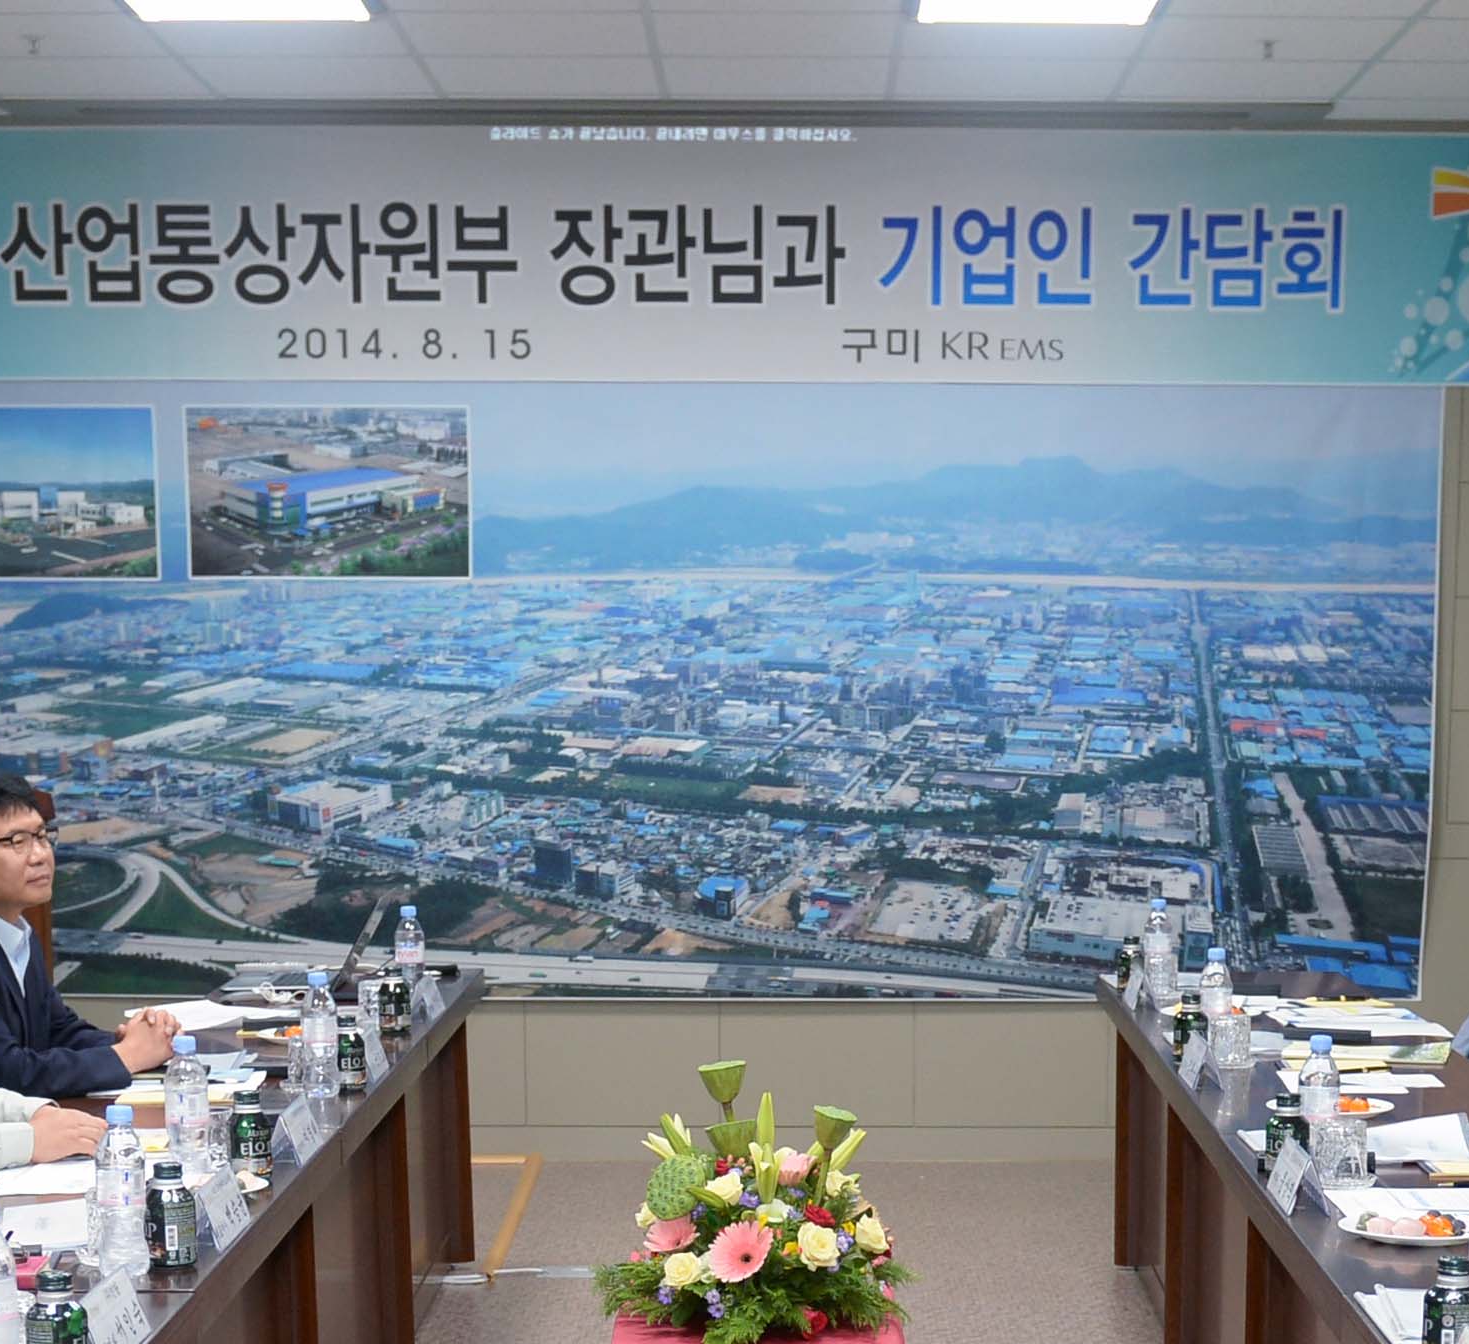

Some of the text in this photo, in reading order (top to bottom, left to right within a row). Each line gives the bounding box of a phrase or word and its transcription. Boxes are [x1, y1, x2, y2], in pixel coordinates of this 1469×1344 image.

[0, 202, 1344, 310] 산업통상자원부 장관님과 기업인 간담회
[277, 328, 532, 360] 2014. 8. 15
[842, 328, 1065, 364] 구미 KR EMS
